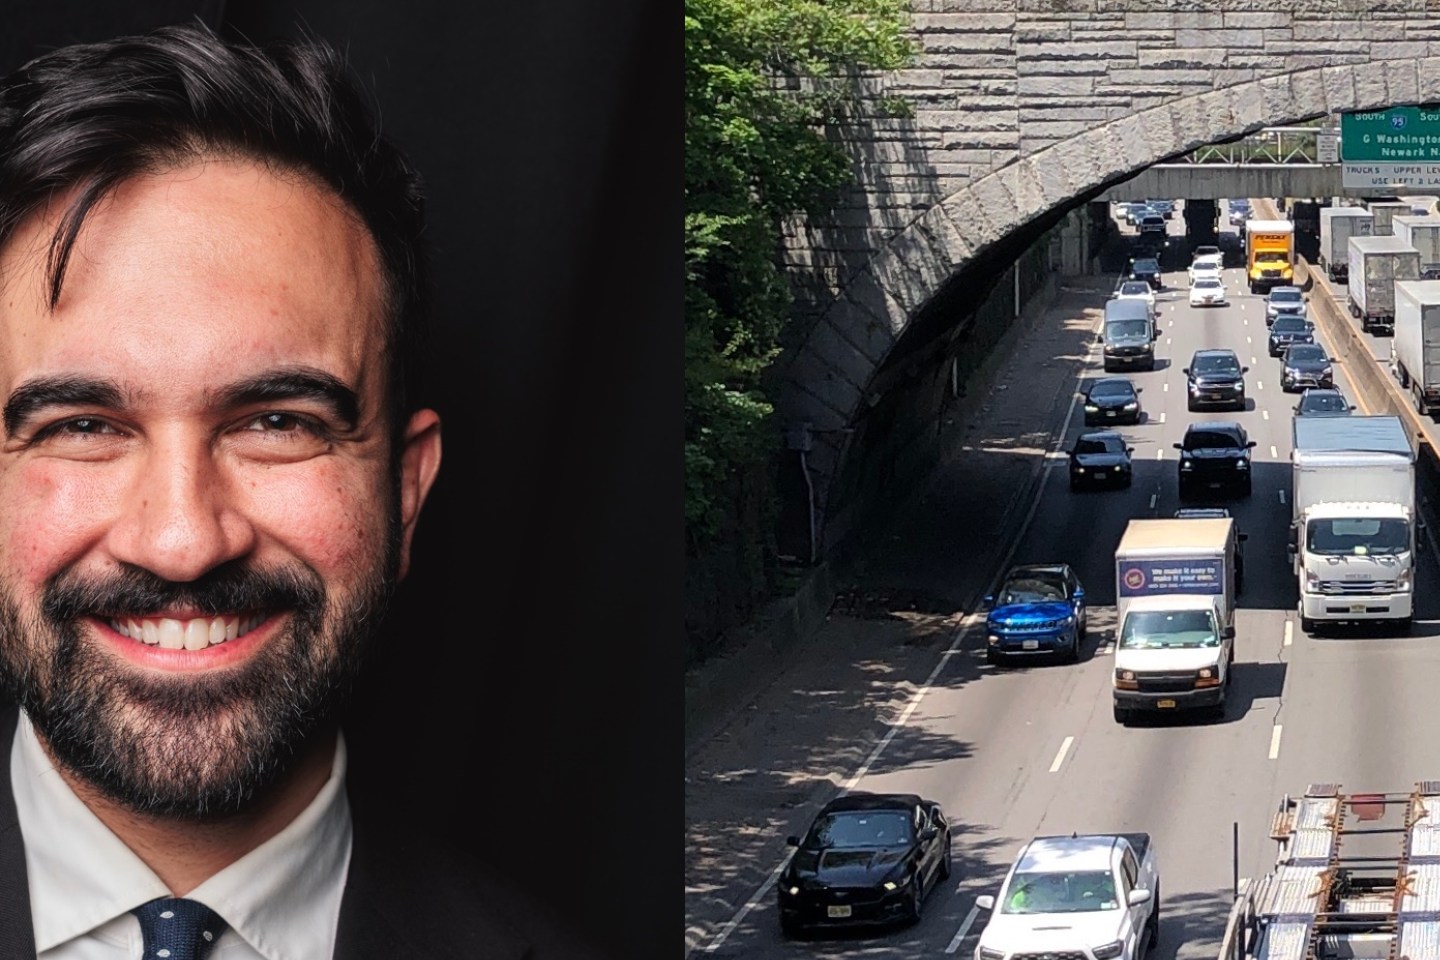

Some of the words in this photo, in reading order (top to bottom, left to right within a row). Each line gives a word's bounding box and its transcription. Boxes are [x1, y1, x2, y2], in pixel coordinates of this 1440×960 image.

[1355, 113, 1386, 121] SOUTH
[1392, 117, 1404, 126] 95
[1363, 134, 1370, 143] G
[1381, 147, 1425, 157] Newark
[1346, 166, 1380, 174] TRUCKS
[1393, 166, 1422, 174] UPPER
[1372, 177, 1388, 185] USE
[1393, 177, 1413, 185] LEFT
